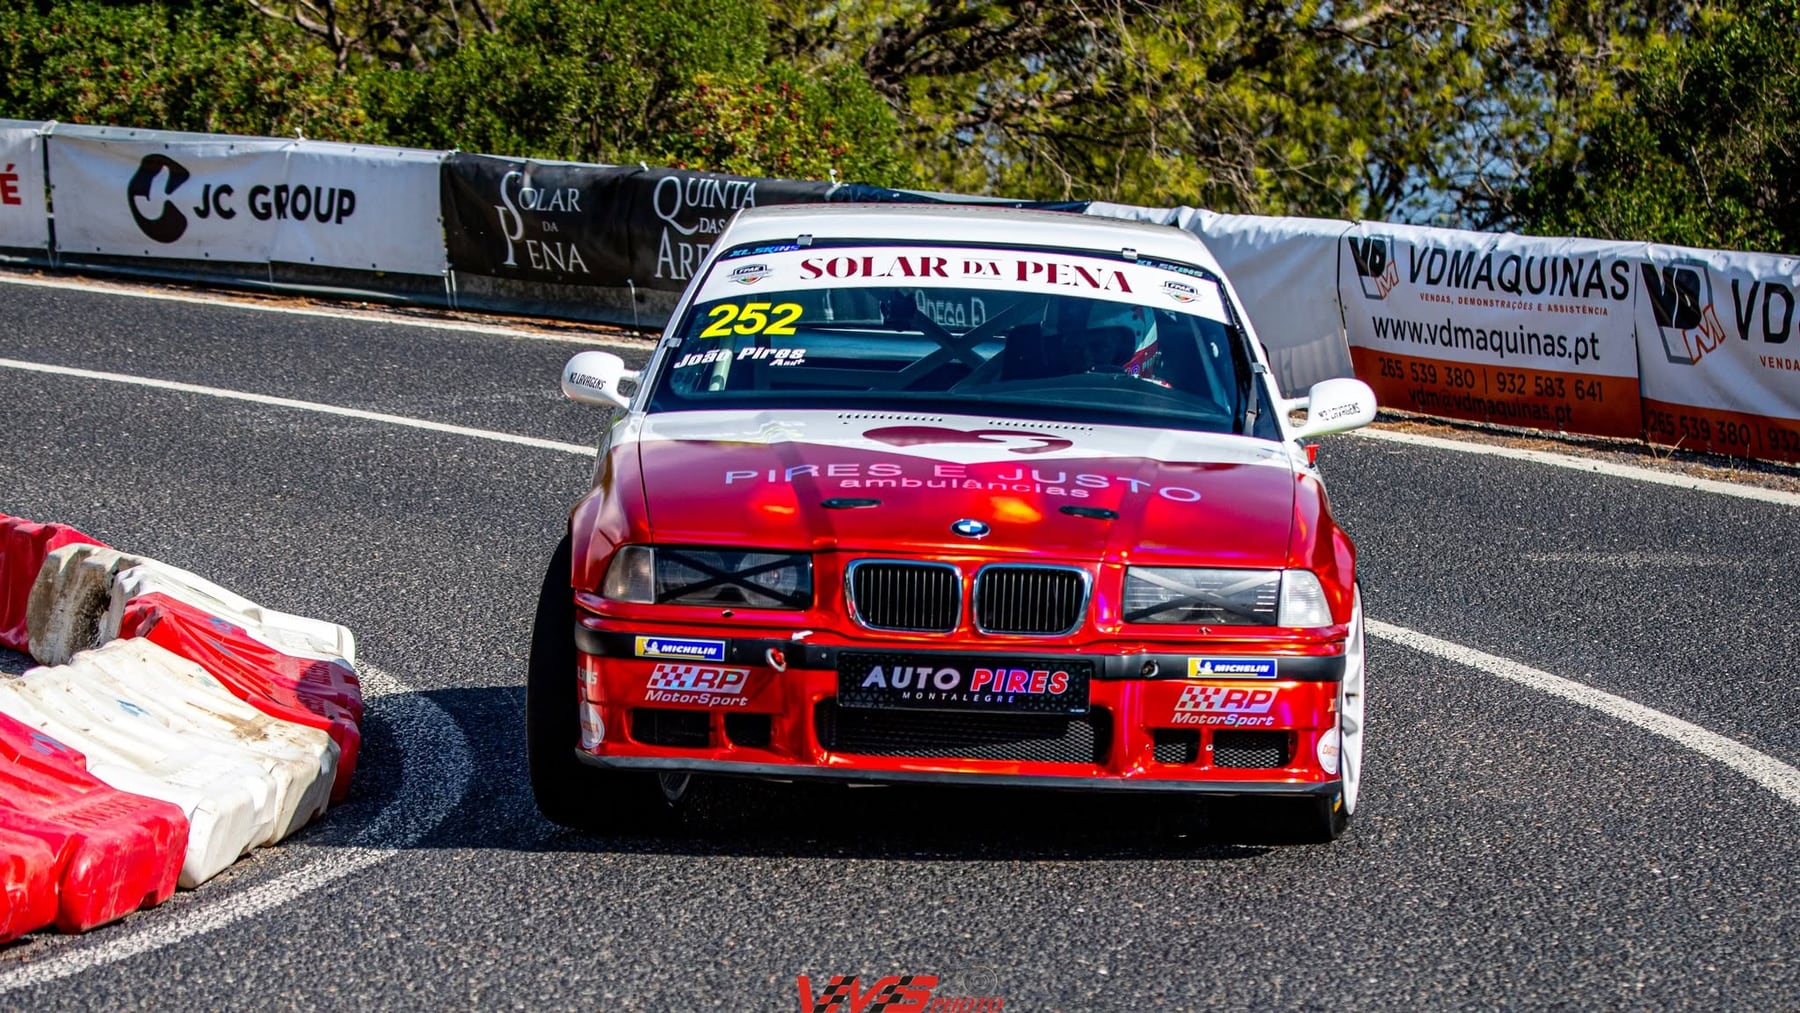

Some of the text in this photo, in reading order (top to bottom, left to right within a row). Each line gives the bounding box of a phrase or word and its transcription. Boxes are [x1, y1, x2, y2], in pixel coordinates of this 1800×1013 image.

[193, 183, 356, 224] JC GROUP
[500, 170, 582, 240] SOLAR
[653, 176, 757, 236] QUINTA
[542, 221, 559, 232] DA
[699, 217, 726, 234] DAS
[494, 205, 590, 273] PENA
[800, 256, 1133, 293] SOLAR DA PENA
[1409, 244, 1629, 301] VDMÁQUINAS
[1420, 292, 1608, 316] VENDAS, DEMONSTRAÇÕES E ASSISTÊNCIA
[699, 303, 804, 339] 252
[1372, 316, 1600, 365] www.vdmaquinas.pt
[673, 347, 807, 369] João Pires
[1379, 357, 1405, 379] 265
[1410, 362, 1437, 384] 539
[1445, 366, 1475, 389] 380
[1497, 371, 1526, 395] 932
[1534, 376, 1565, 398] 583
[1574, 380, 1603, 402] 641
[1680, 413, 1710, 440] 539
[1716, 421, 1750, 446] 380
[725, 464, 1201, 502] PIRES E JUSTO
[839, 477, 1090, 498] ambulâncias
[661, 644, 717, 656] MICHELIN
[692, 669, 746, 690] RP
[862, 666, 1069, 695] AUTO PIRES
[1214, 664, 1270, 673] MICHELIN
[645, 690, 748, 707] MotorSport
[902, 692, 1015, 704] MONTALEGRE
[1220, 690, 1273, 710] RP
[1171, 712, 1275, 727] MotorSport
